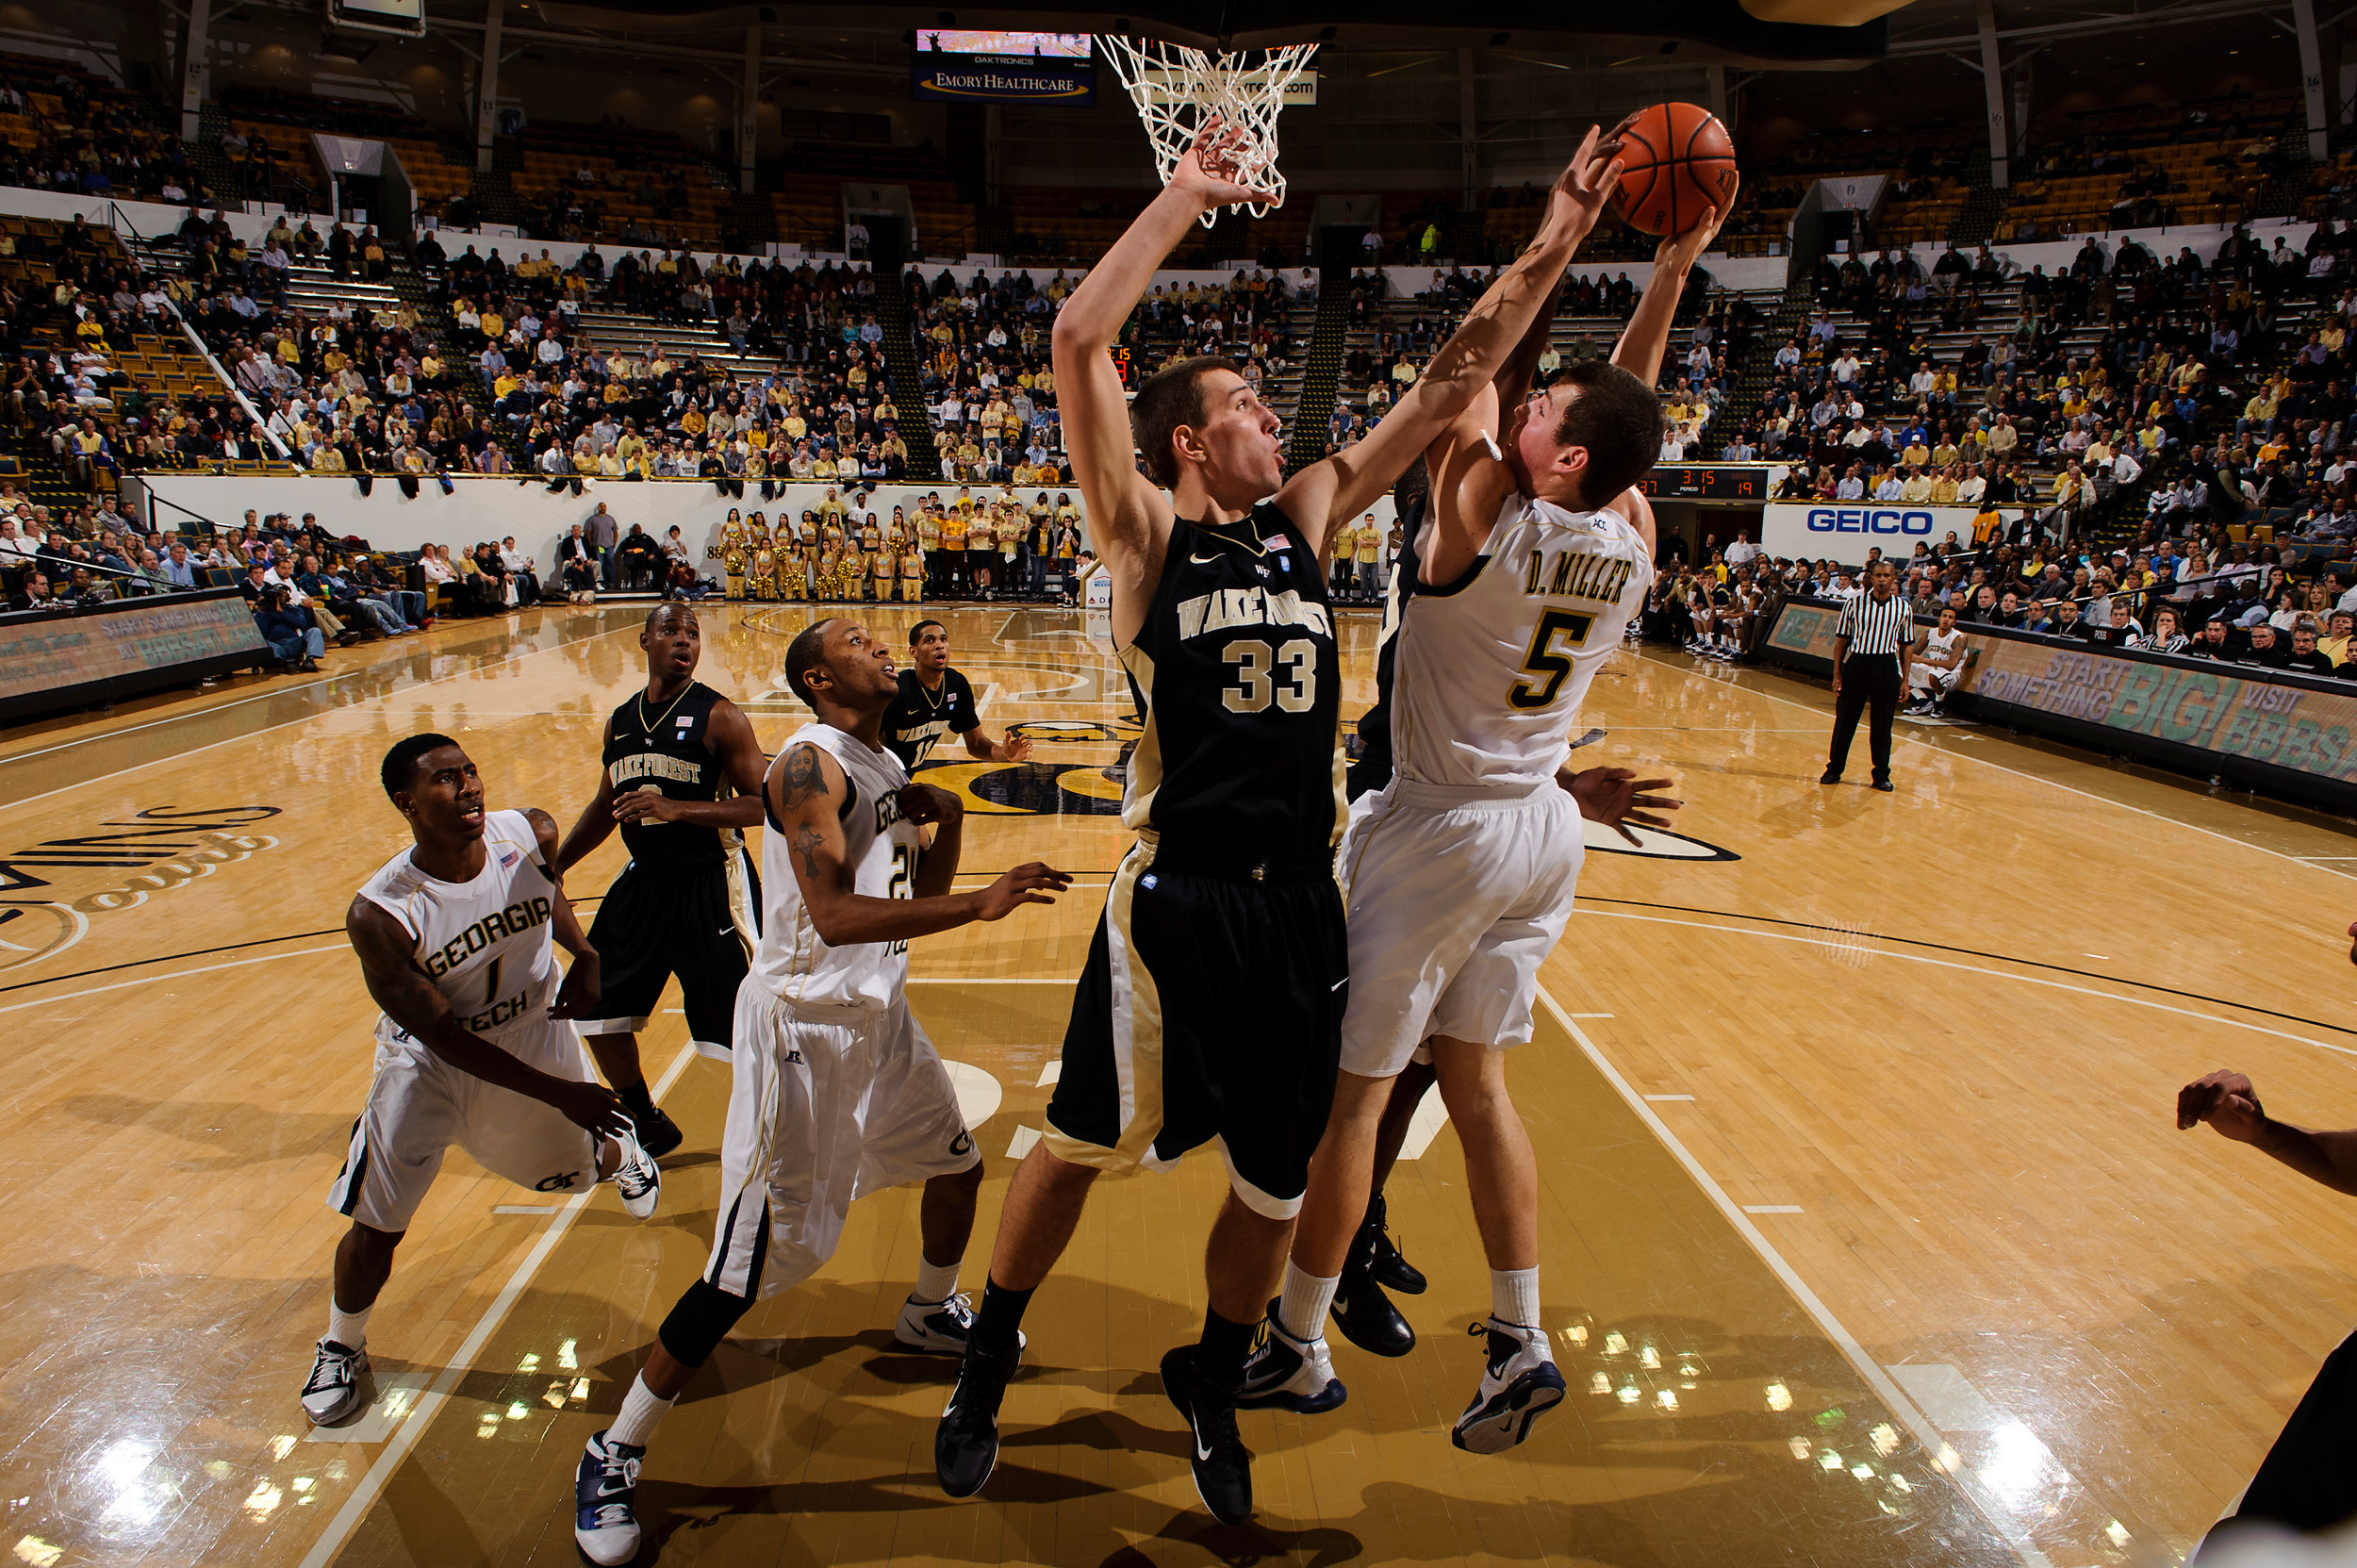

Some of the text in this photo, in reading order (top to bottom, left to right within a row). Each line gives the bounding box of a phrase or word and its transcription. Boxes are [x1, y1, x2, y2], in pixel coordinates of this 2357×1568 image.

[190, 63, 201, 74] 12
[975, 56, 1034, 65] DAKTRONICS
[936, 73, 1075, 91] EMORY HEALTHCARE
[2308, 76, 2319, 86] 16
[1640, 480, 1657, 494] 37
[1702, 485, 1706, 495] 1
[1738, 481, 1752, 496] 19
[1683, 470, 1715, 485] 3:15
[1592, 518, 1607, 531] ACC
[1807, 509, 1933, 535] GEICO
[1255, 564, 1270, 578] WF
[1524, 550, 1632, 605] D. MILLER
[101, 616, 146, 639] START
[147, 606, 221, 633] SOMETHING
[1177, 586, 1263, 640] WAKE
[2094, 629, 2107, 640] POSS
[118, 641, 138, 659] AT
[1506, 605, 1598, 711] 5
[1222, 639, 1316, 713] 33
[2047, 650, 2303, 715] START VISIT
[1976, 666, 2113, 720] SOMETHING
[2106, 662, 2240, 749] BIG!
[643, 752, 701, 784] FOREST
[425, 896, 552, 978] GEORGIA
[482, 952, 505, 1008] 1
